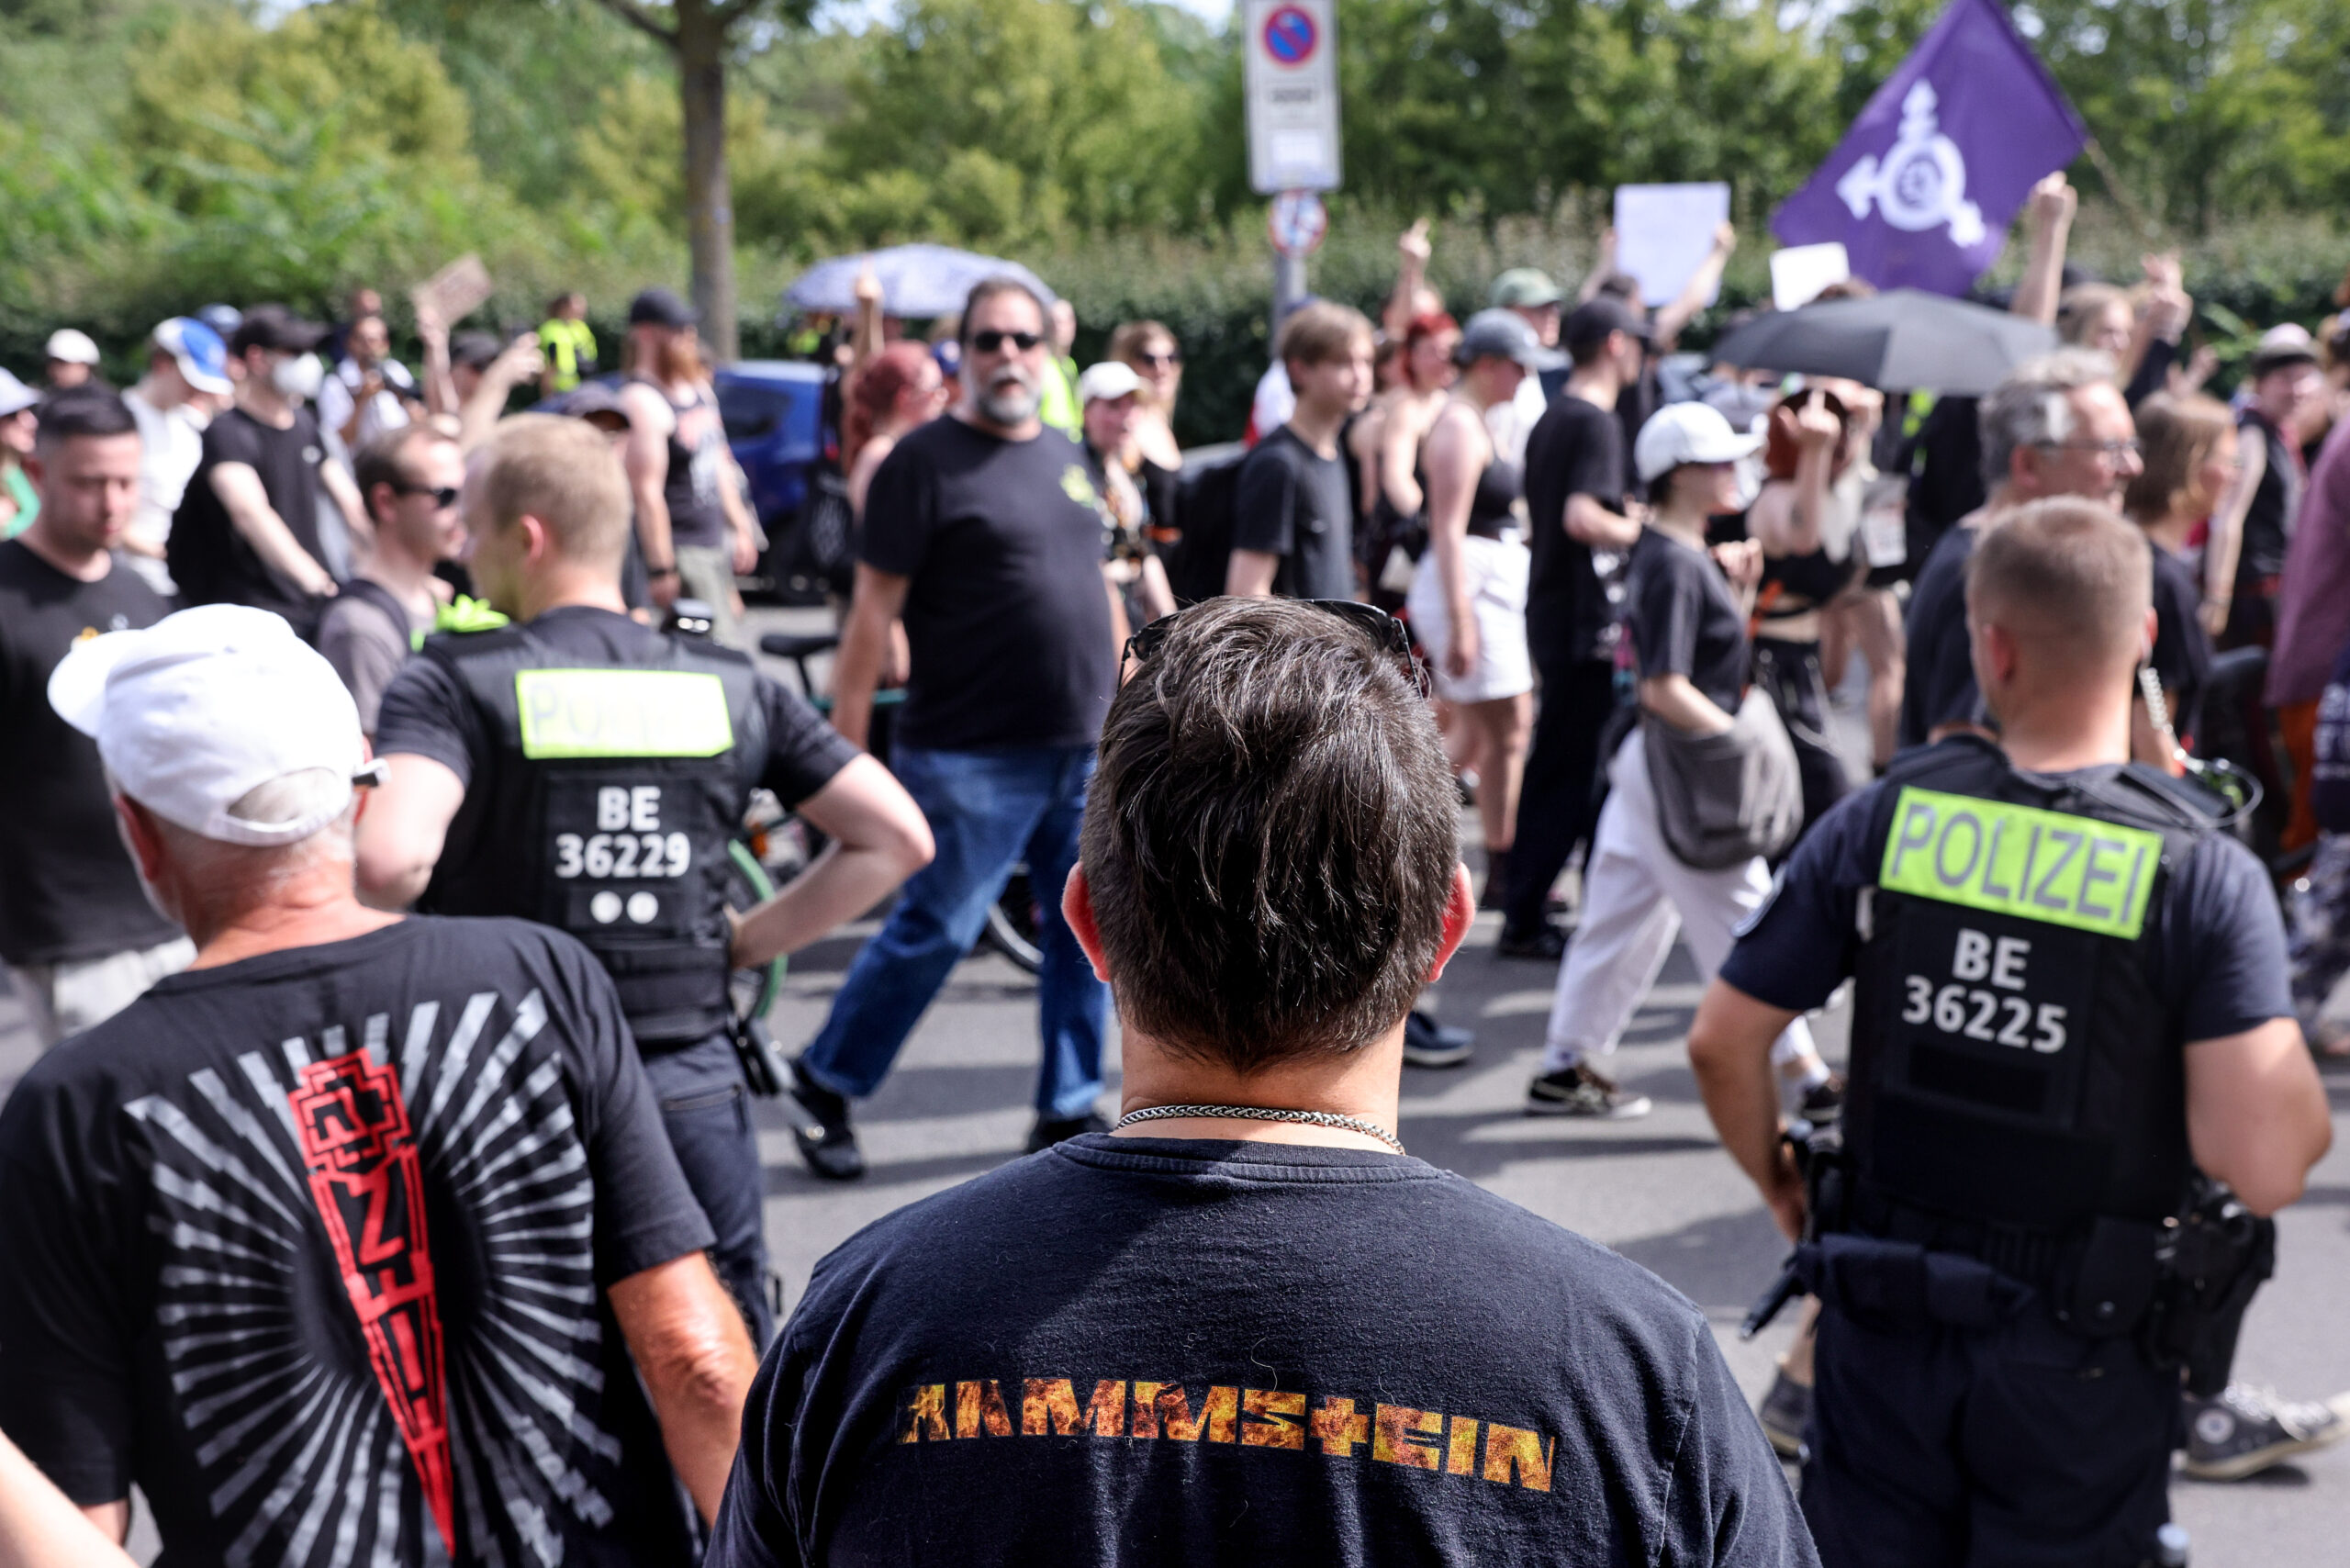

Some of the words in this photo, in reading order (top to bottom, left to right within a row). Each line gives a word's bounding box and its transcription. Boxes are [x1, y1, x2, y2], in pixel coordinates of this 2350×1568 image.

[597, 786, 661, 831] BE
[554, 832, 691, 879] 36229
[1891, 801, 2145, 925] POLIZEI
[1952, 927, 2031, 991] BE
[1901, 974, 2067, 1054] 36225
[896, 1378, 1559, 1493] RAMMSTEIN
